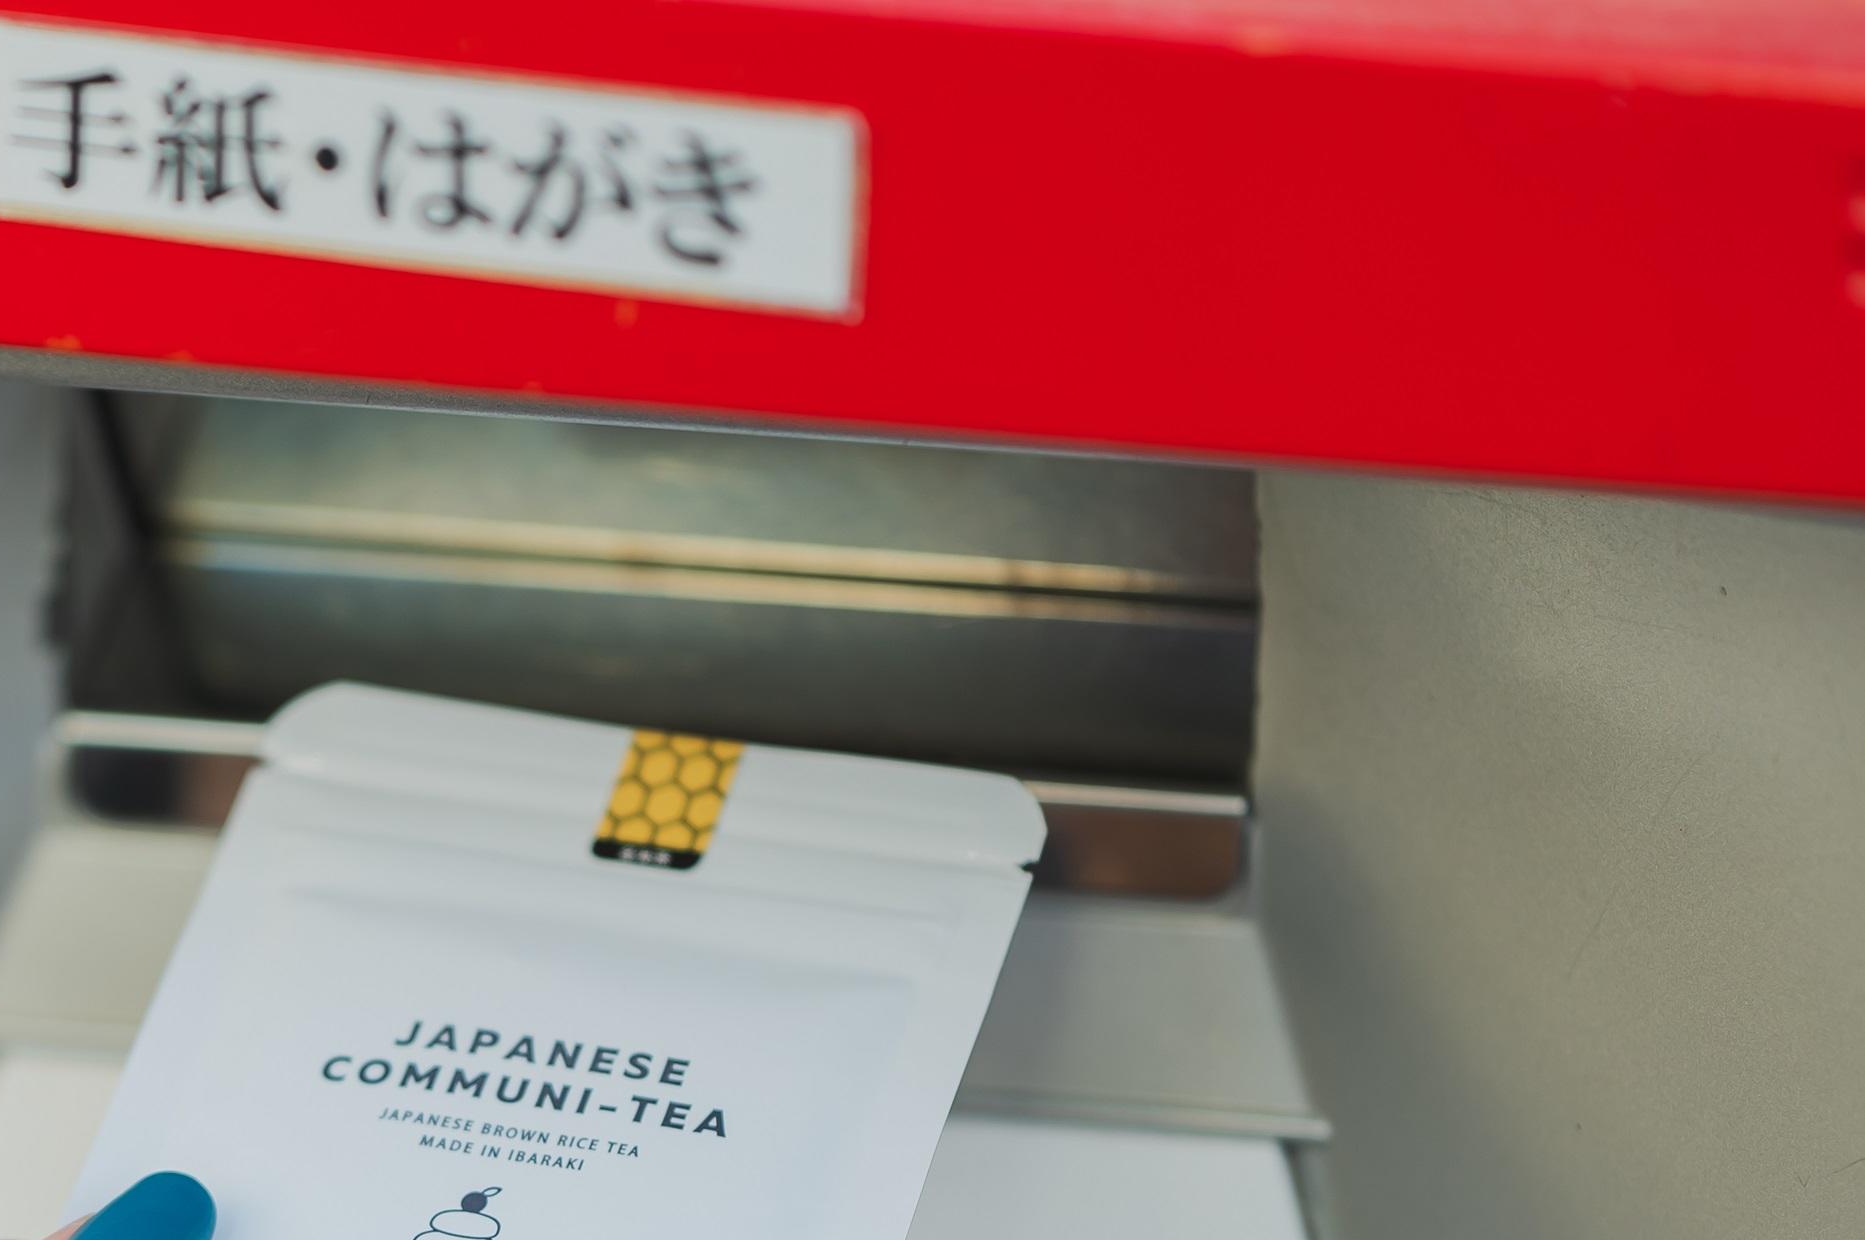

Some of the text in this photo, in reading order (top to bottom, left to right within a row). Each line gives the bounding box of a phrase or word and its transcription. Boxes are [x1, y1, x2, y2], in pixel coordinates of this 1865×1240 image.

[10, 70, 764, 268] 手紙・はがき
[394, 1019, 691, 1087] JAPANESE
[321, 1055, 728, 1138] COMMUNI-TEA
[378, 1106, 641, 1158] JAPANESE BROWN RICE TEA
[419, 1134, 586, 1172] MADE IN IBARAKI
